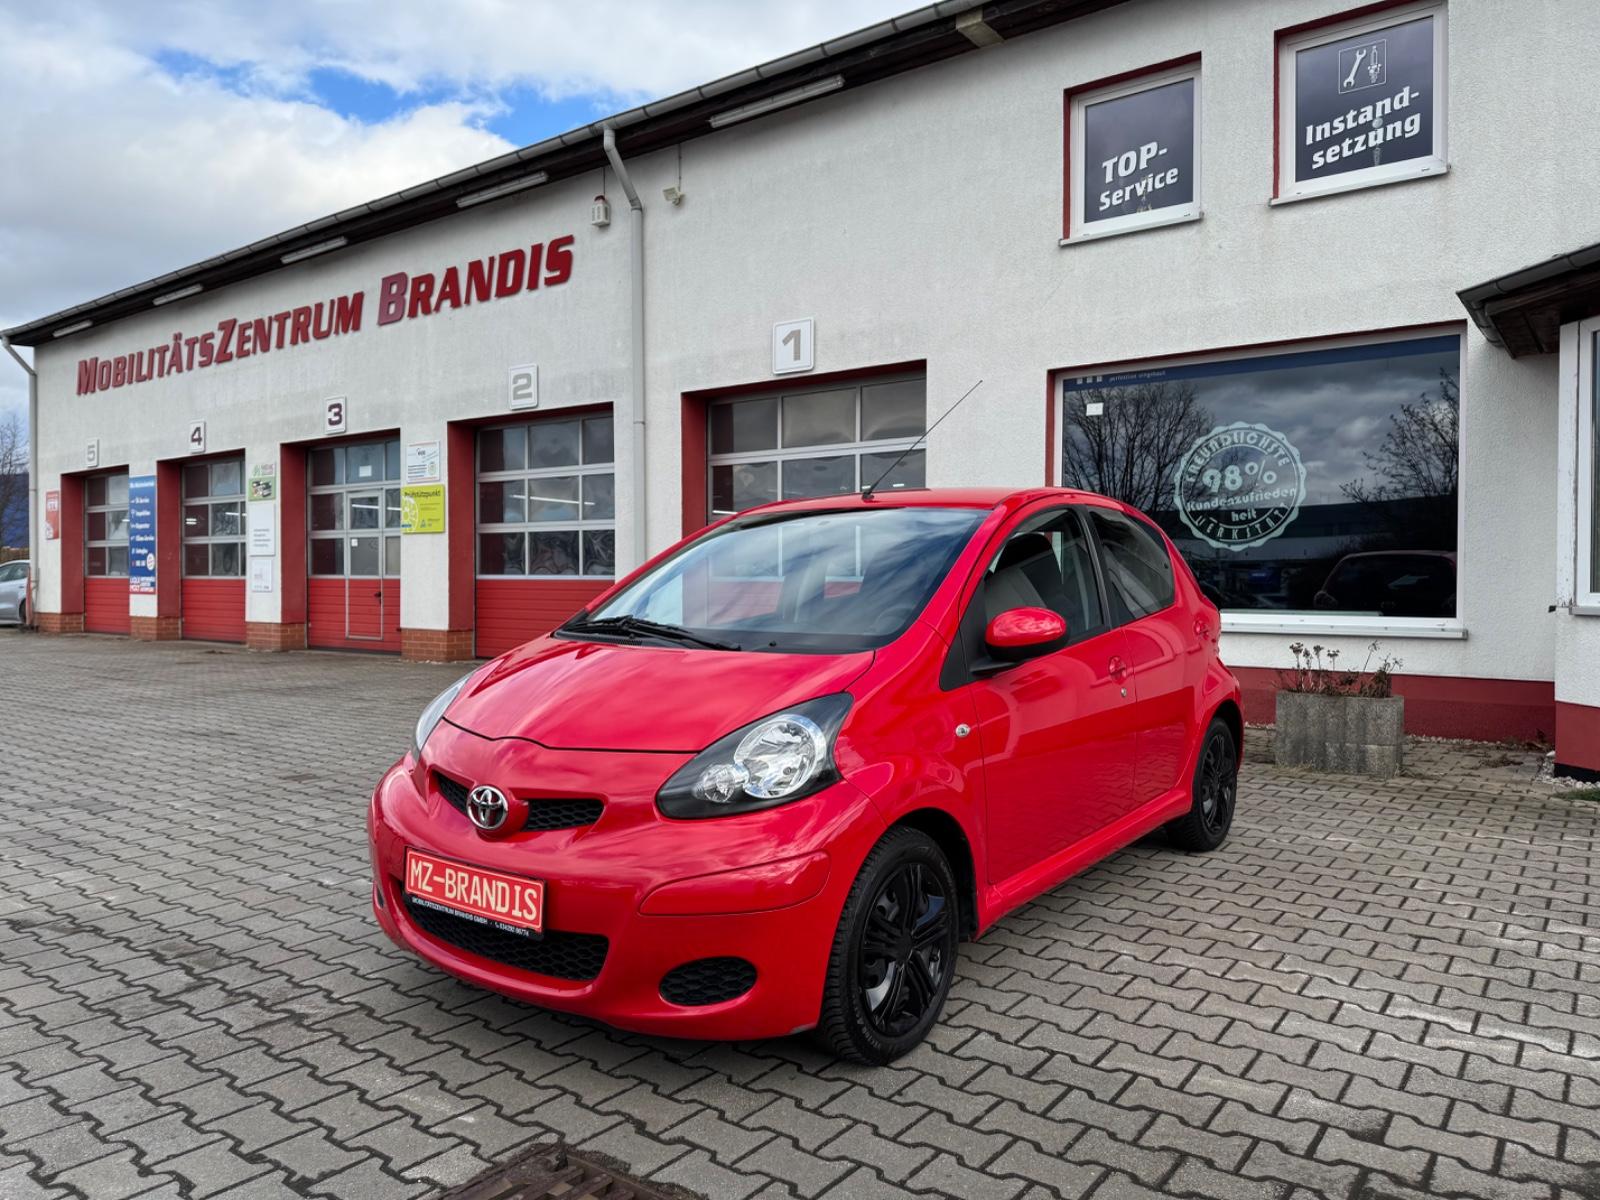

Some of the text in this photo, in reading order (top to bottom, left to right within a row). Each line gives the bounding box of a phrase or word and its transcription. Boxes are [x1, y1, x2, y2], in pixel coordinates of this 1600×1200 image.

[1305, 86, 1420, 145] Instand-
[1312, 113, 1421, 169] setzung
[1102, 141, 1168, 184] TOP-
[1099, 167, 1179, 211] Service
[377, 234, 575, 326] BRANDIS
[782, 329, 801, 361] 1
[512, 373, 533, 400] 2
[328, 402, 343, 426] 3
[87, 445, 96, 461] 5
[191, 426, 203, 446] 4
[1186, 431, 1290, 482] FREUNDLICHSTE
[1187, 488, 1297, 511] Kundenzufrieden
[1231, 508, 1257, 522] heit
[1196, 502, 1289, 540] WERKSTATT
[410, 858, 538, 921] MZ-BRANDIS
